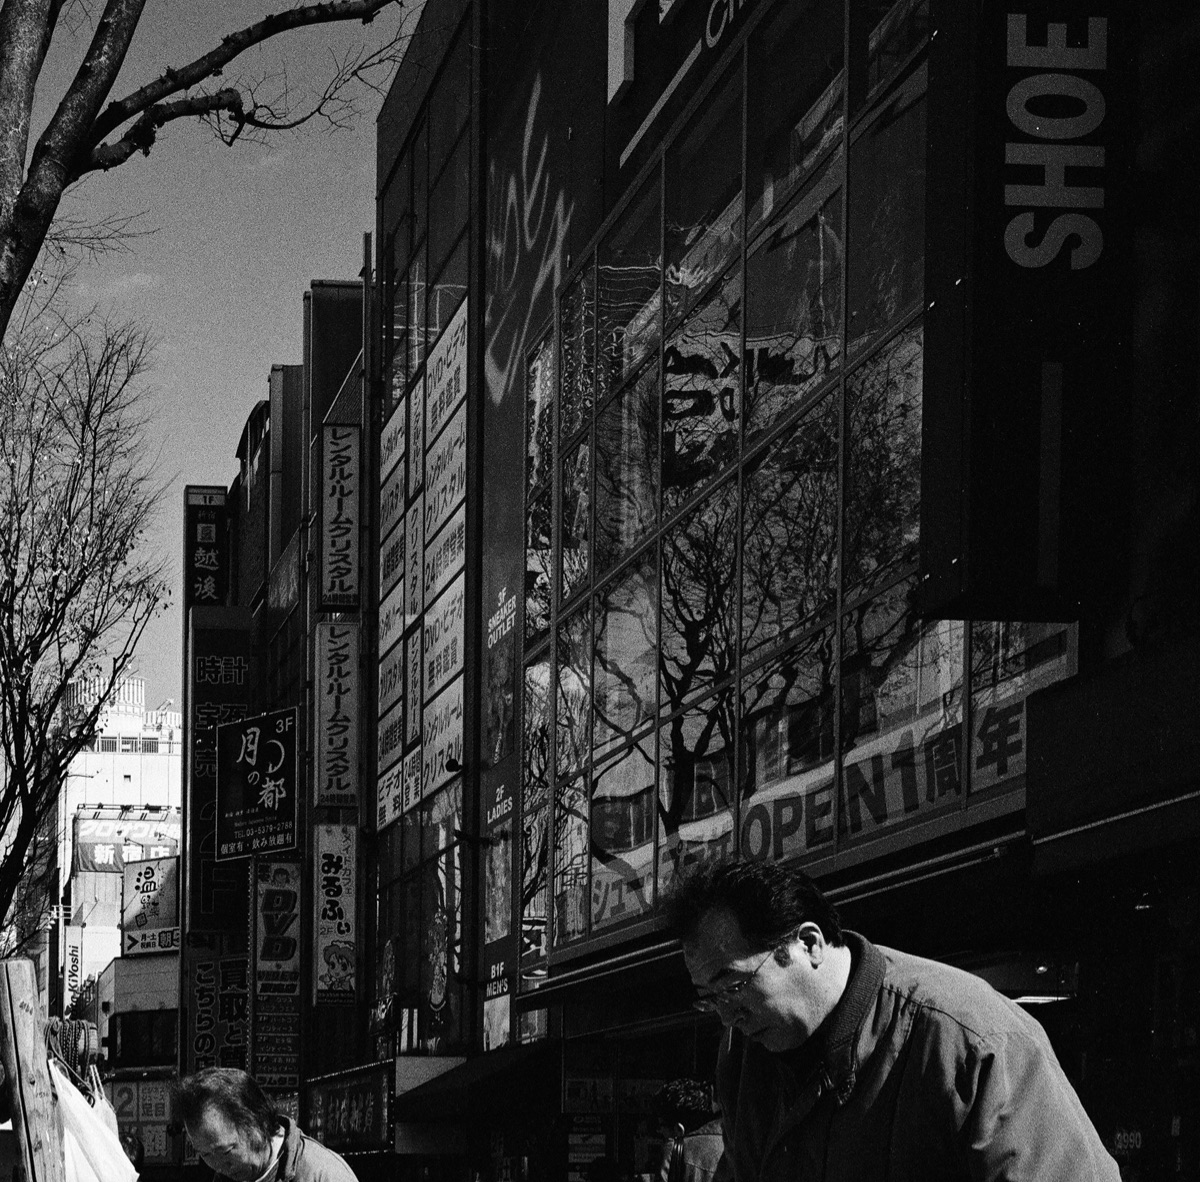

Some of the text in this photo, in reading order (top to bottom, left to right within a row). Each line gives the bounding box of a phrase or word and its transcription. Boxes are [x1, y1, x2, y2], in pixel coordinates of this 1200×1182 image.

[1003, 13, 1108, 270] SHOE
[426, 461, 465, 535] クリスタル
[487, 594, 517, 633] SNEAKER
[487, 611, 517, 649] OUTLET
[195, 655, 248, 685] 時計
[275, 716, 294, 734] 3F
[236, 726, 287, 811] 月の都
[487, 795, 513, 824] LADIES
[260, 888, 299, 961] DVD
[486, 977, 509, 997] MEN'S
